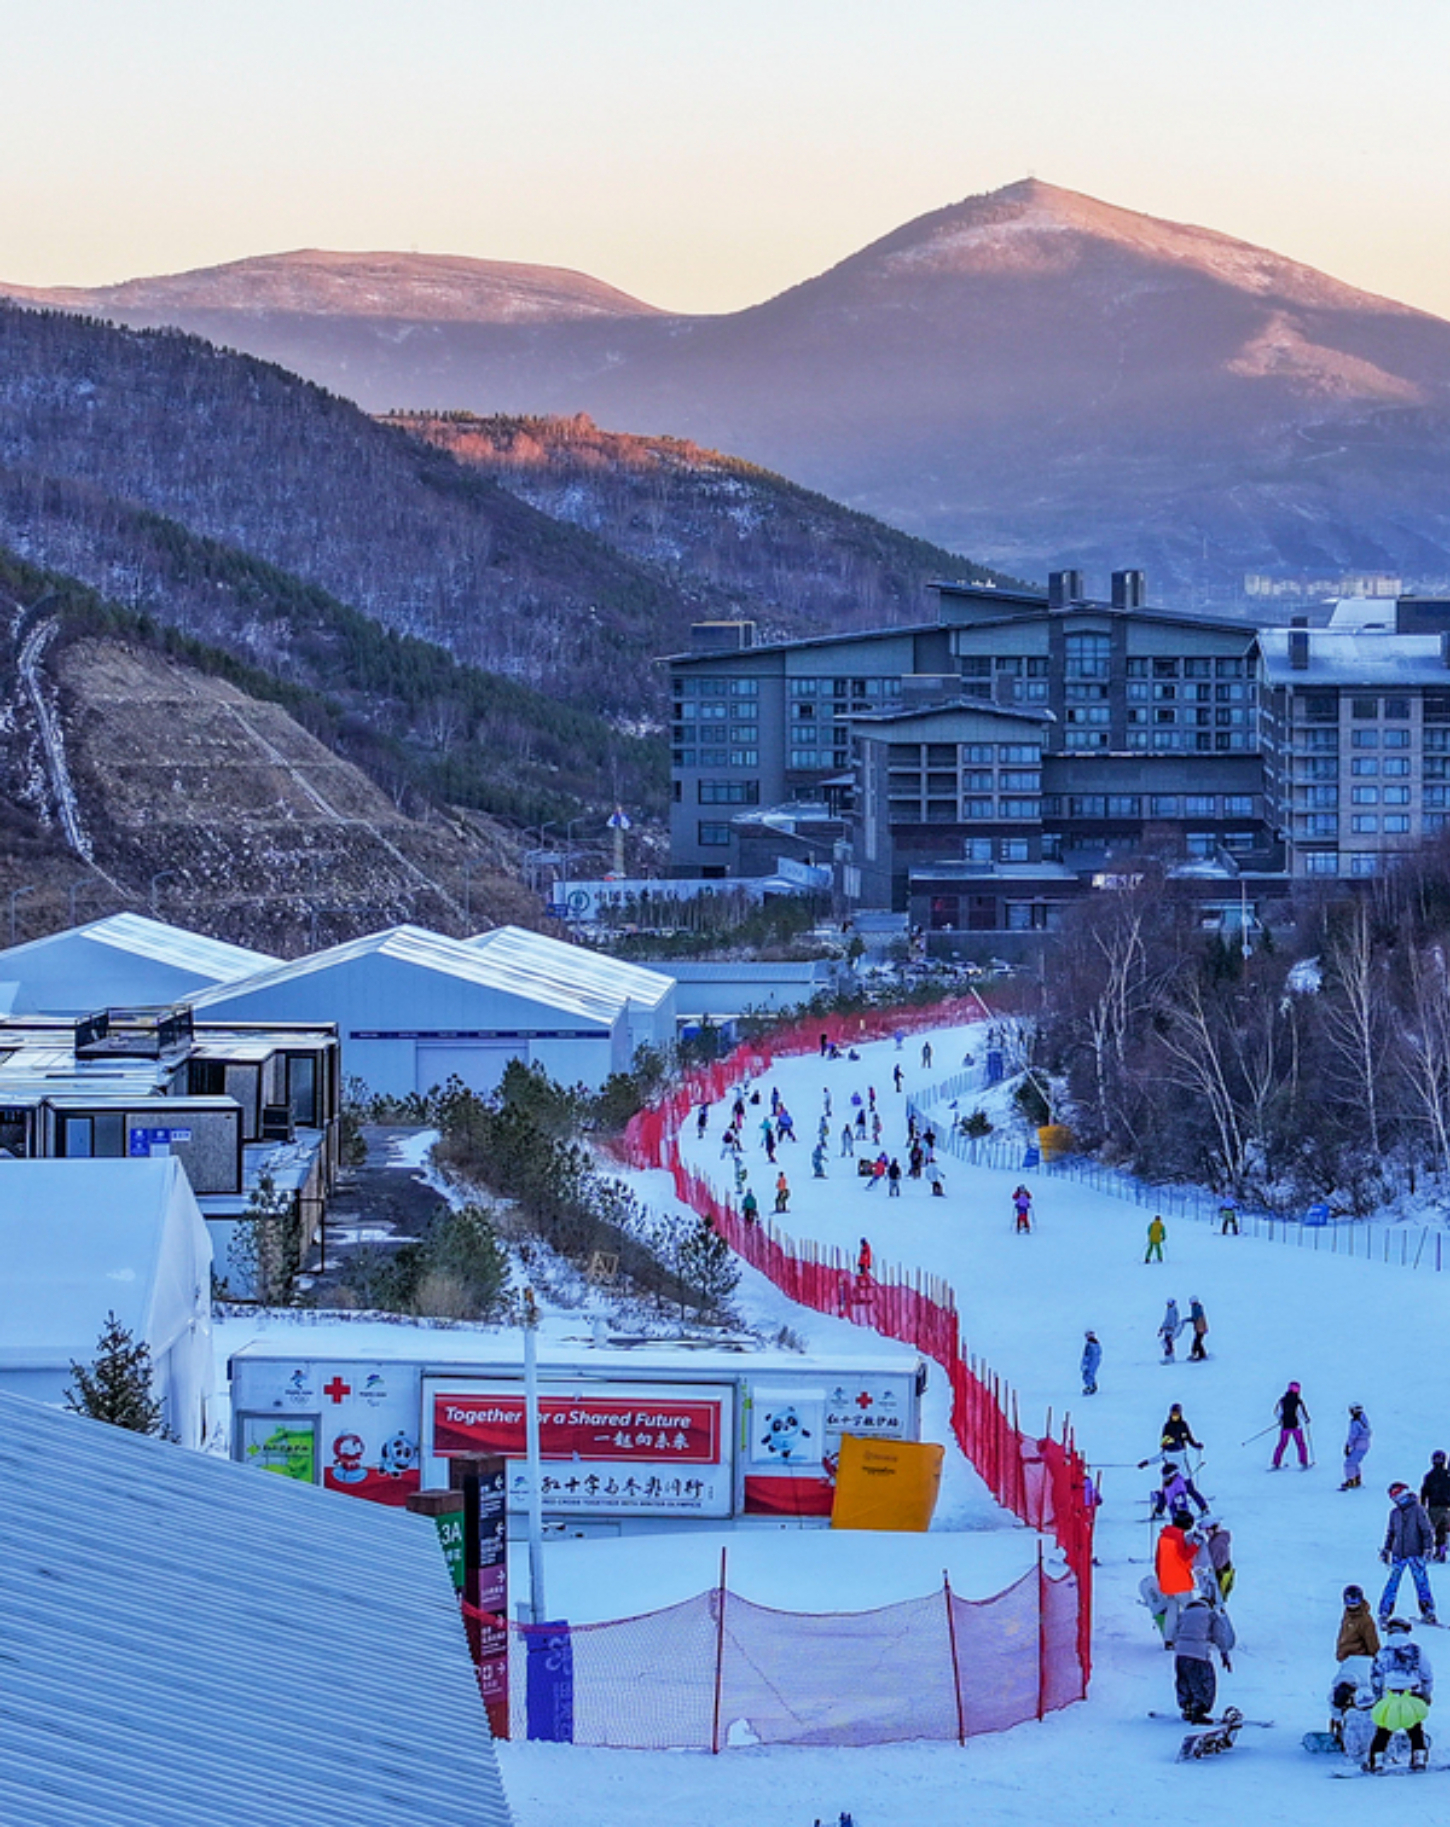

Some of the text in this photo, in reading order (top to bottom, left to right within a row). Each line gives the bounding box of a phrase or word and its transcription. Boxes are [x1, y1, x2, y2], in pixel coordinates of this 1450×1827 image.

[445, 1406, 523, 1426] Together
[553, 1412, 566, 1425] a
[568, 1409, 632, 1427] Shared
[635, 1412, 692, 1429] Future
[594, 1430, 690, 1451] 一起向未来
